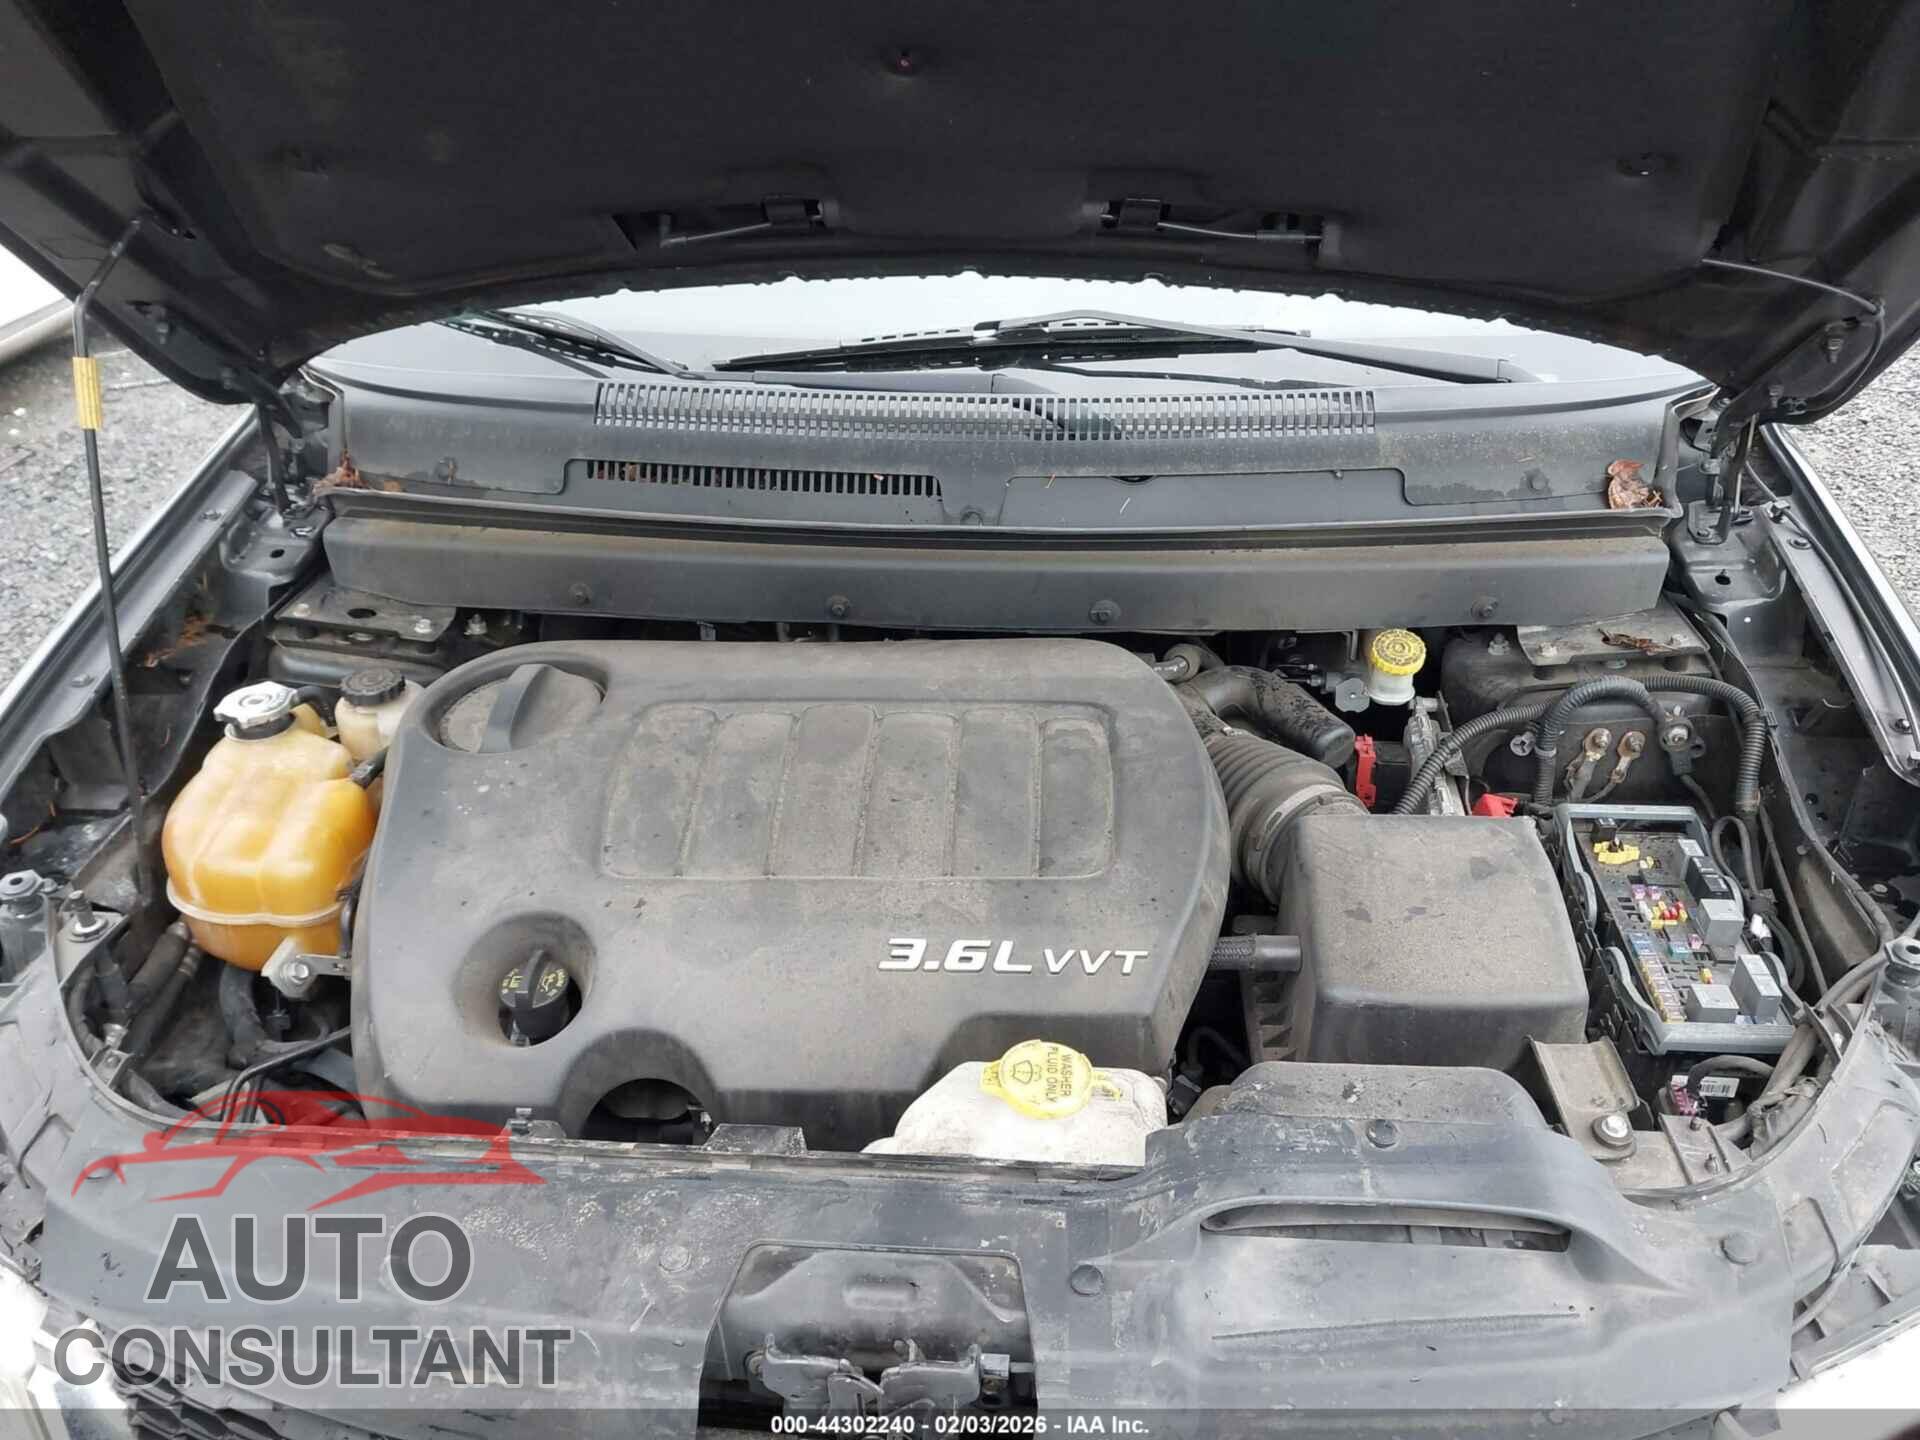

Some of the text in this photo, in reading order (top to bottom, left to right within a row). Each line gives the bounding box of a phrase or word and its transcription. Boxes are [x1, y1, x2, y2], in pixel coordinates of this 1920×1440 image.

[878, 937, 1149, 975] 3.6L VVT
[1046, 1046, 1059, 1103] FLUID ONLY
[1060, 1054, 1073, 1097] WASHER
